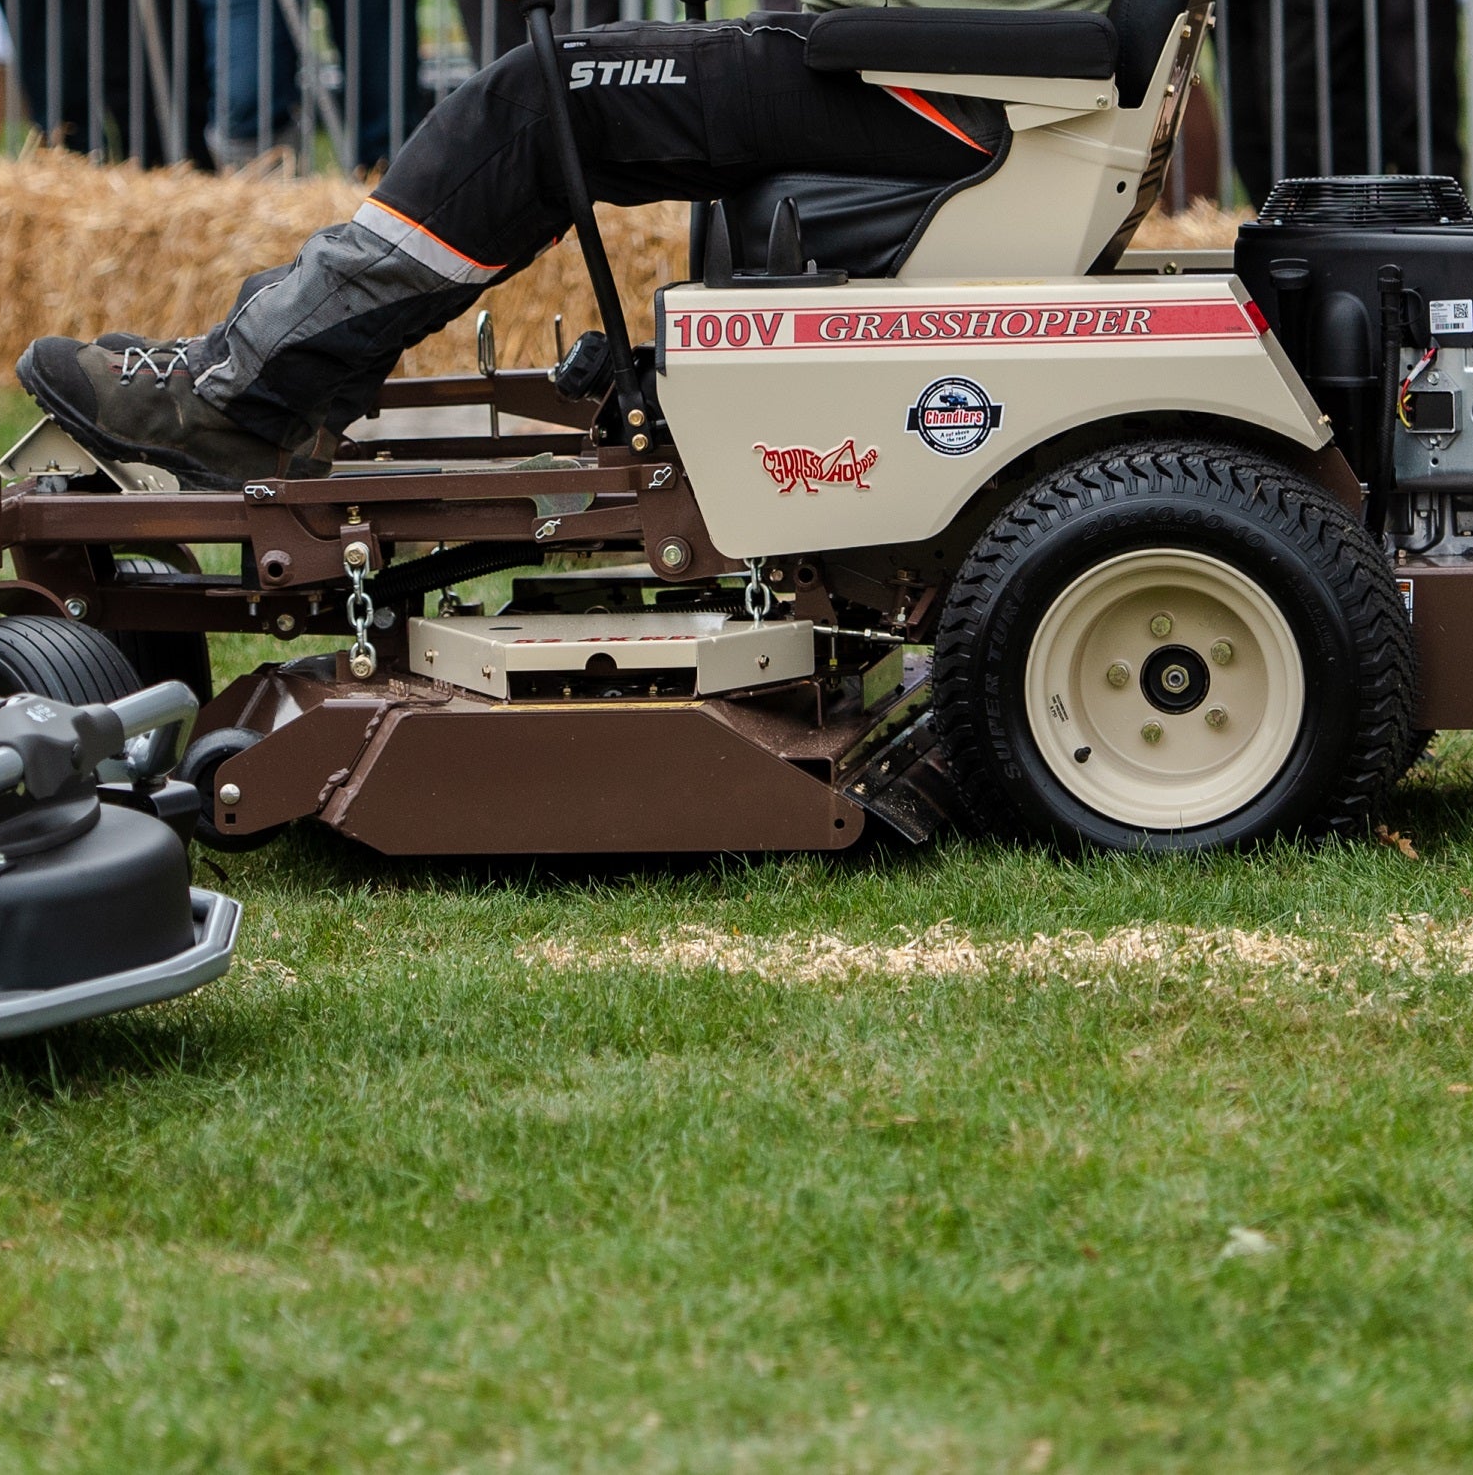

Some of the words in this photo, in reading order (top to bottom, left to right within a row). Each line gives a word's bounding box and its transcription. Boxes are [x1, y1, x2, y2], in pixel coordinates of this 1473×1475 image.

[569, 58, 687, 90] STIHL
[674, 313, 784, 347] 100V
[818, 308, 1153, 341] GRASSHOPPER
[925, 409, 983, 425] Chandlers
[752, 438, 879, 493] GRASSHOPPER
[984, 673, 1023, 780] SUPER
